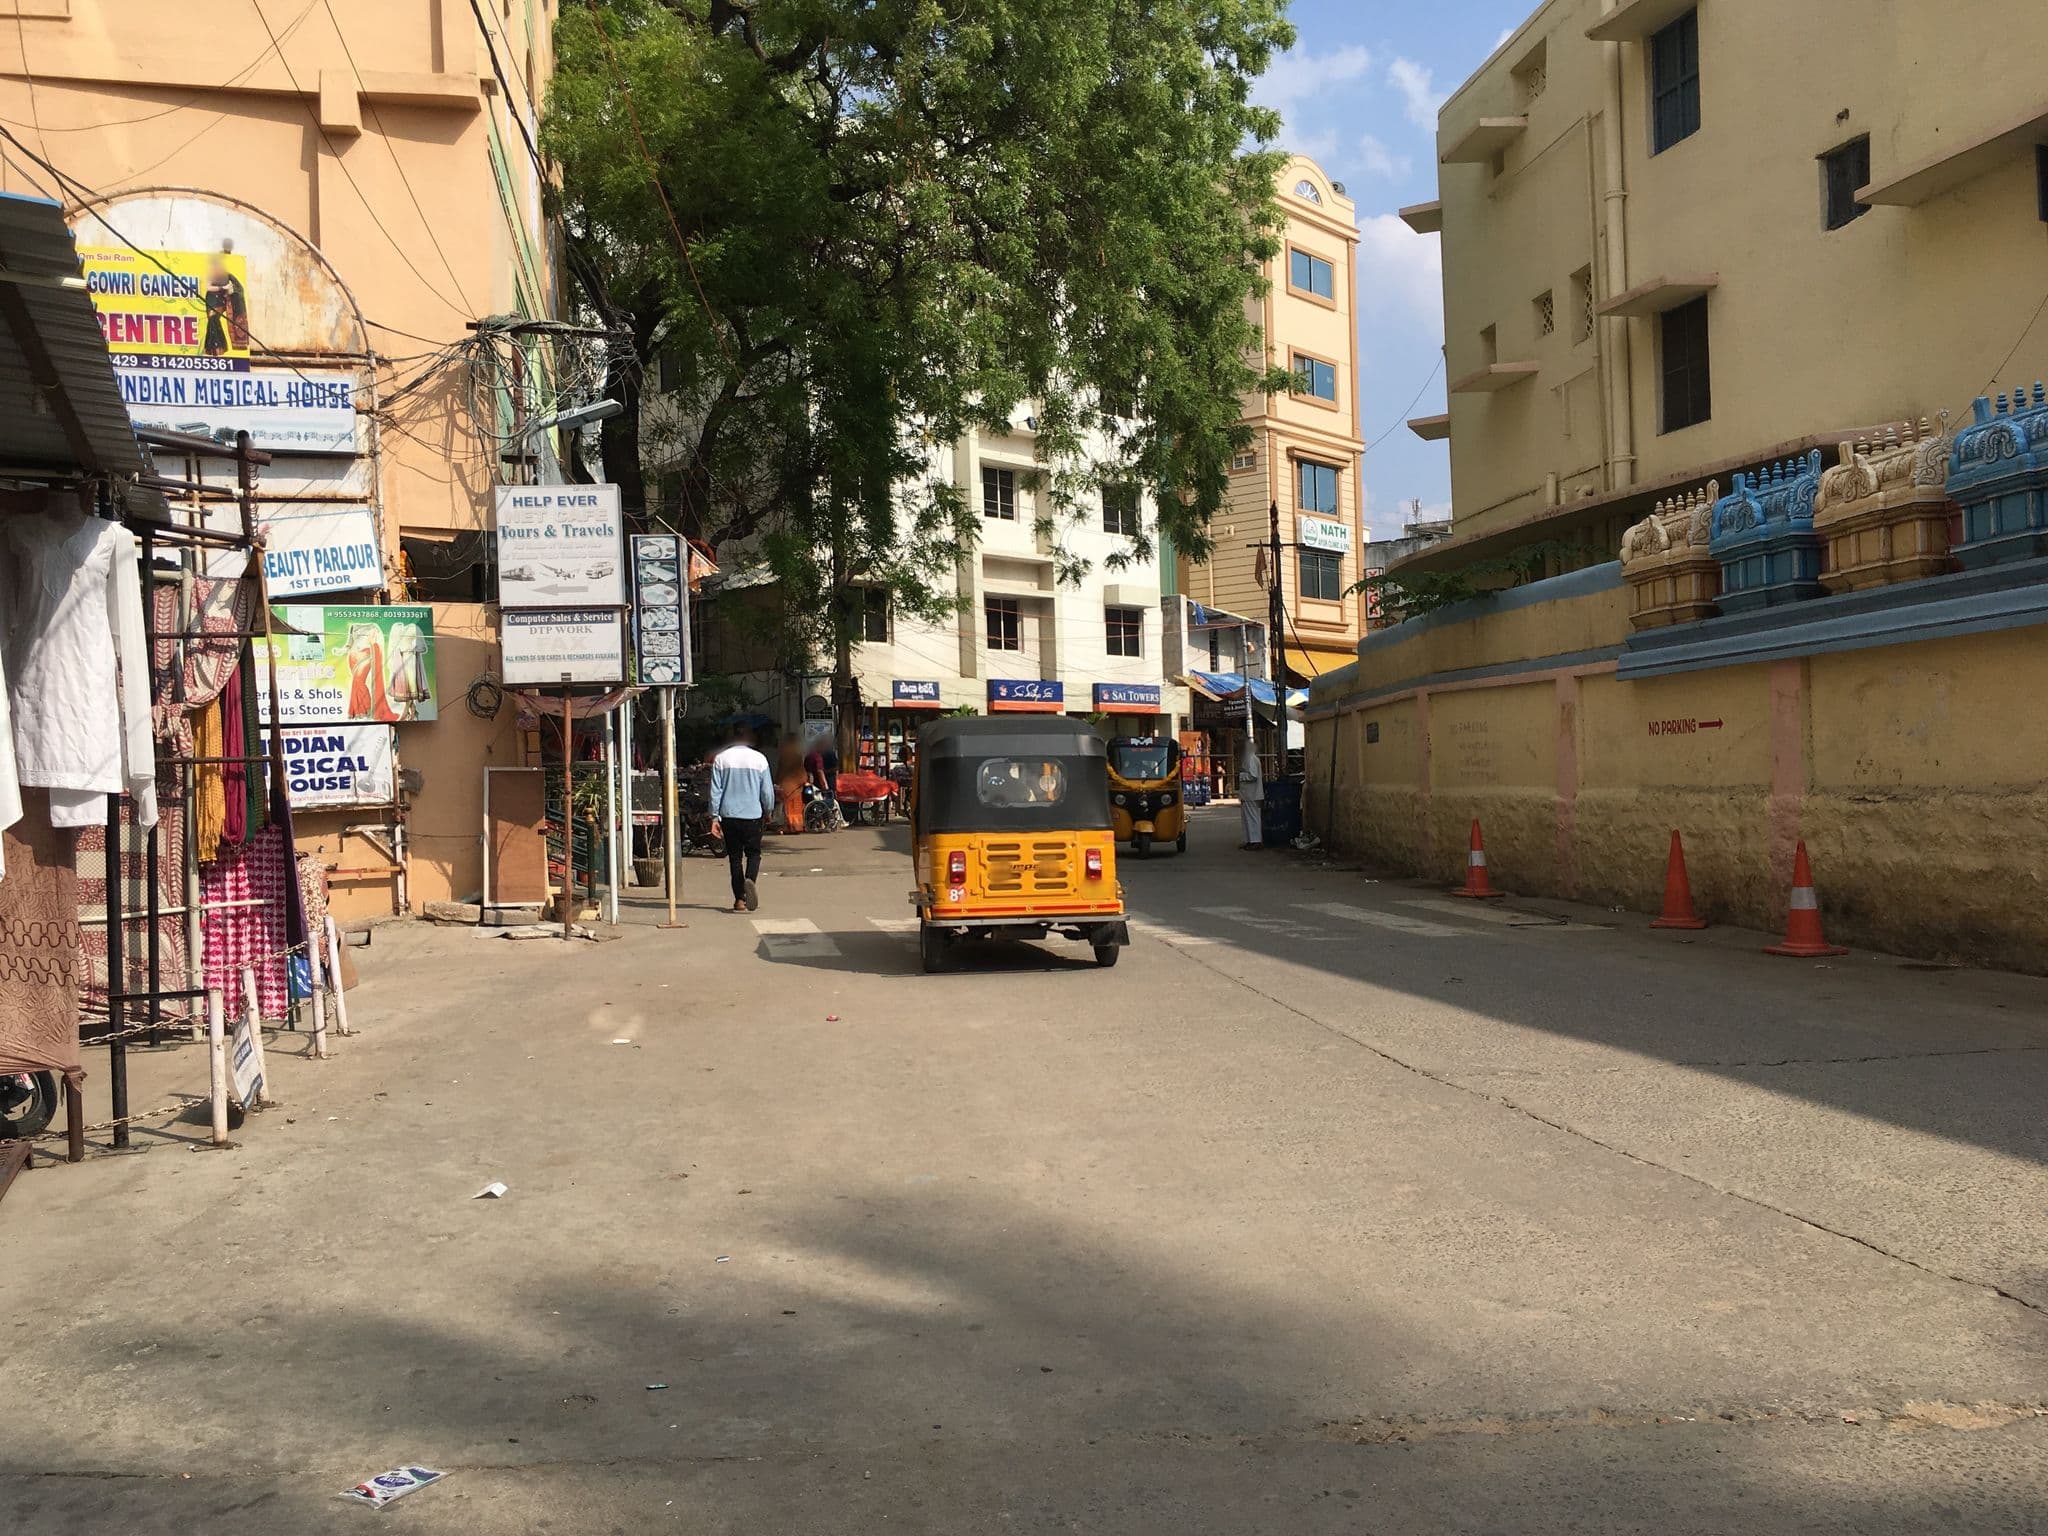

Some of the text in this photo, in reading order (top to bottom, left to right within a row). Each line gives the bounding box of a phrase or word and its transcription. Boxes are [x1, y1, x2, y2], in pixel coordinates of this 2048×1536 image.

[97, 253, 112, 261] Sai
[114, 254, 135, 262] Ram
[88, 271, 199, 299] GOWRI GANESH
[109, 355, 138, 367] 429
[151, 357, 234, 371] 8142055361
[195, 378, 279, 407] MUSICAL
[286, 381, 351, 410] HOUSE
[512, 495, 597, 507] HELP EVER
[499, 523, 614, 539] Tours & Travels
[1320, 523, 1347, 539] NATH
[263, 543, 376, 578] BEAUTY PARLOUR
[289, 574, 351, 589] 1ST FLOOR
[508, 612, 613, 625] Computer Sales & Service
[529, 625, 593, 635] DTP WORK
[294, 688, 305, 700] &
[308, 688, 343, 700] Shols
[1112, 691, 1160, 703] SAI TOWERS
[299, 704, 343, 716] Stones
[1648, 718, 1697, 736] NO PARKING
[260, 735, 345, 756] IDIAN
[288, 775, 352, 793] OUSE
